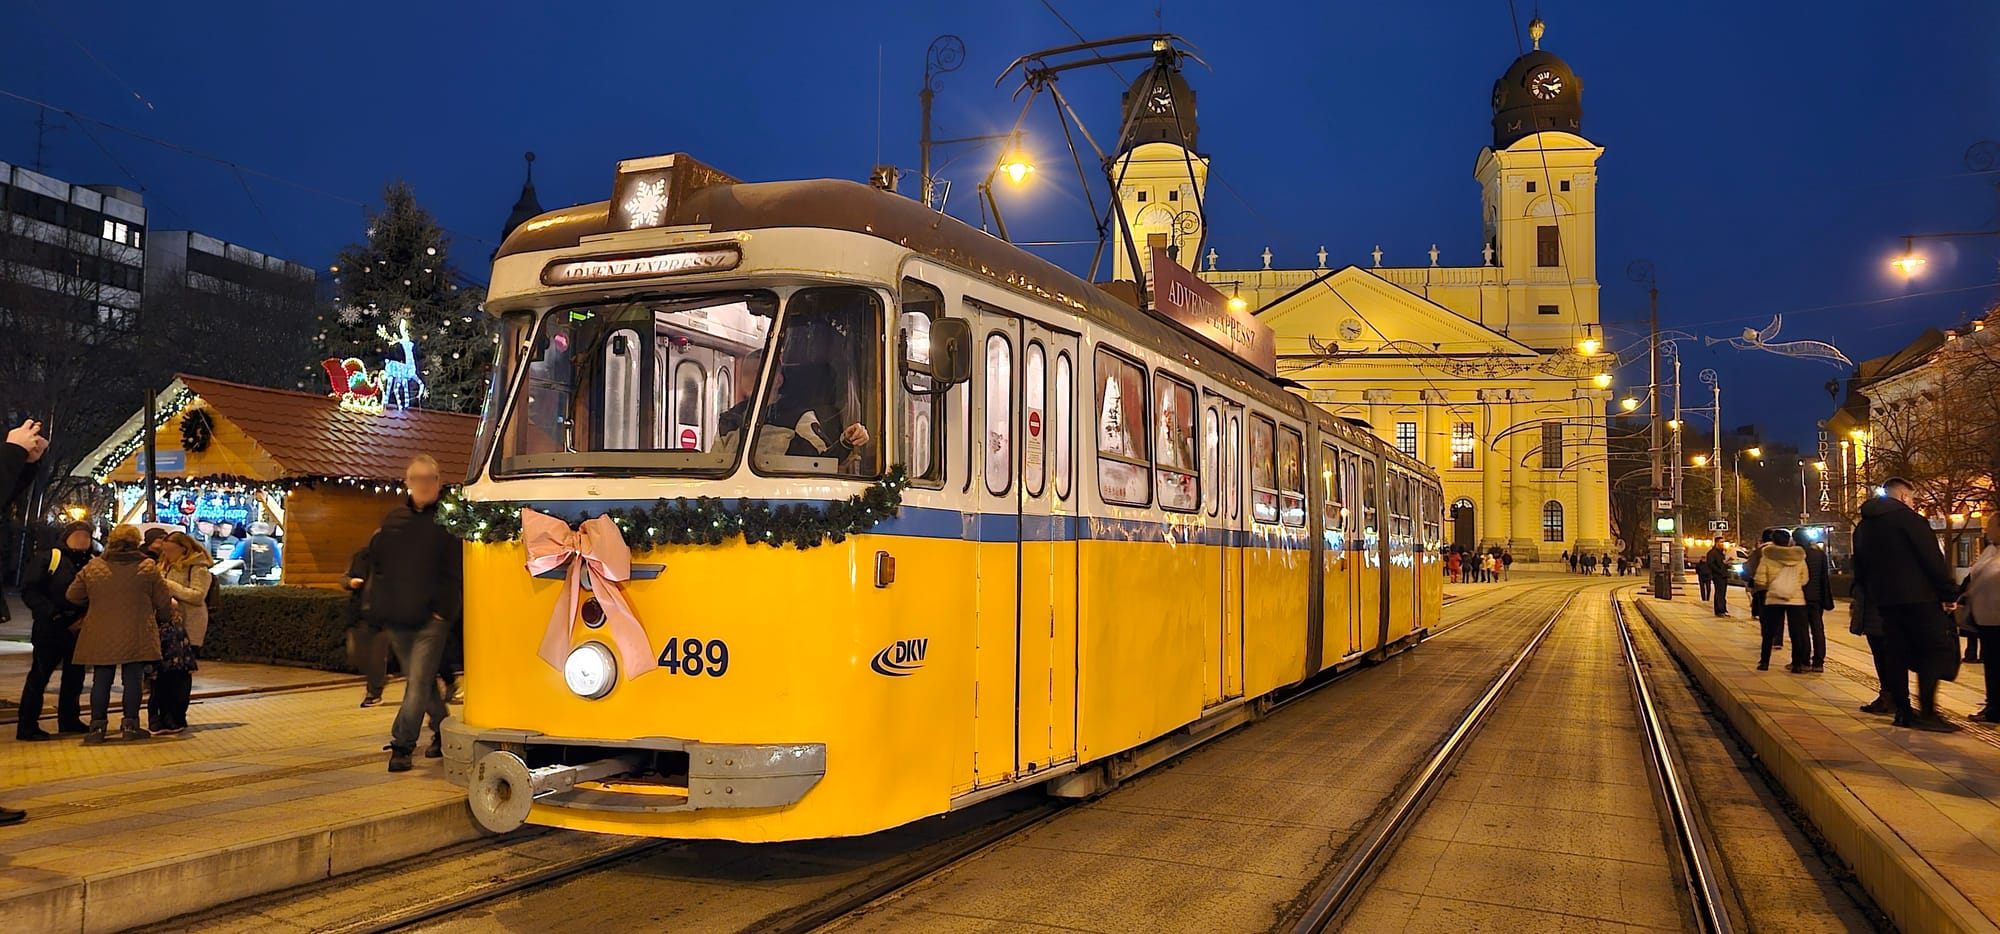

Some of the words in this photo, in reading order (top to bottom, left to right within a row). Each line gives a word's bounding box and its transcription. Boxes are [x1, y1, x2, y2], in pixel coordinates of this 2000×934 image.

[1168, 279, 1212, 323] ADVENT
[657, 637, 729, 678] 489
[895, 638, 928, 664] DKV
